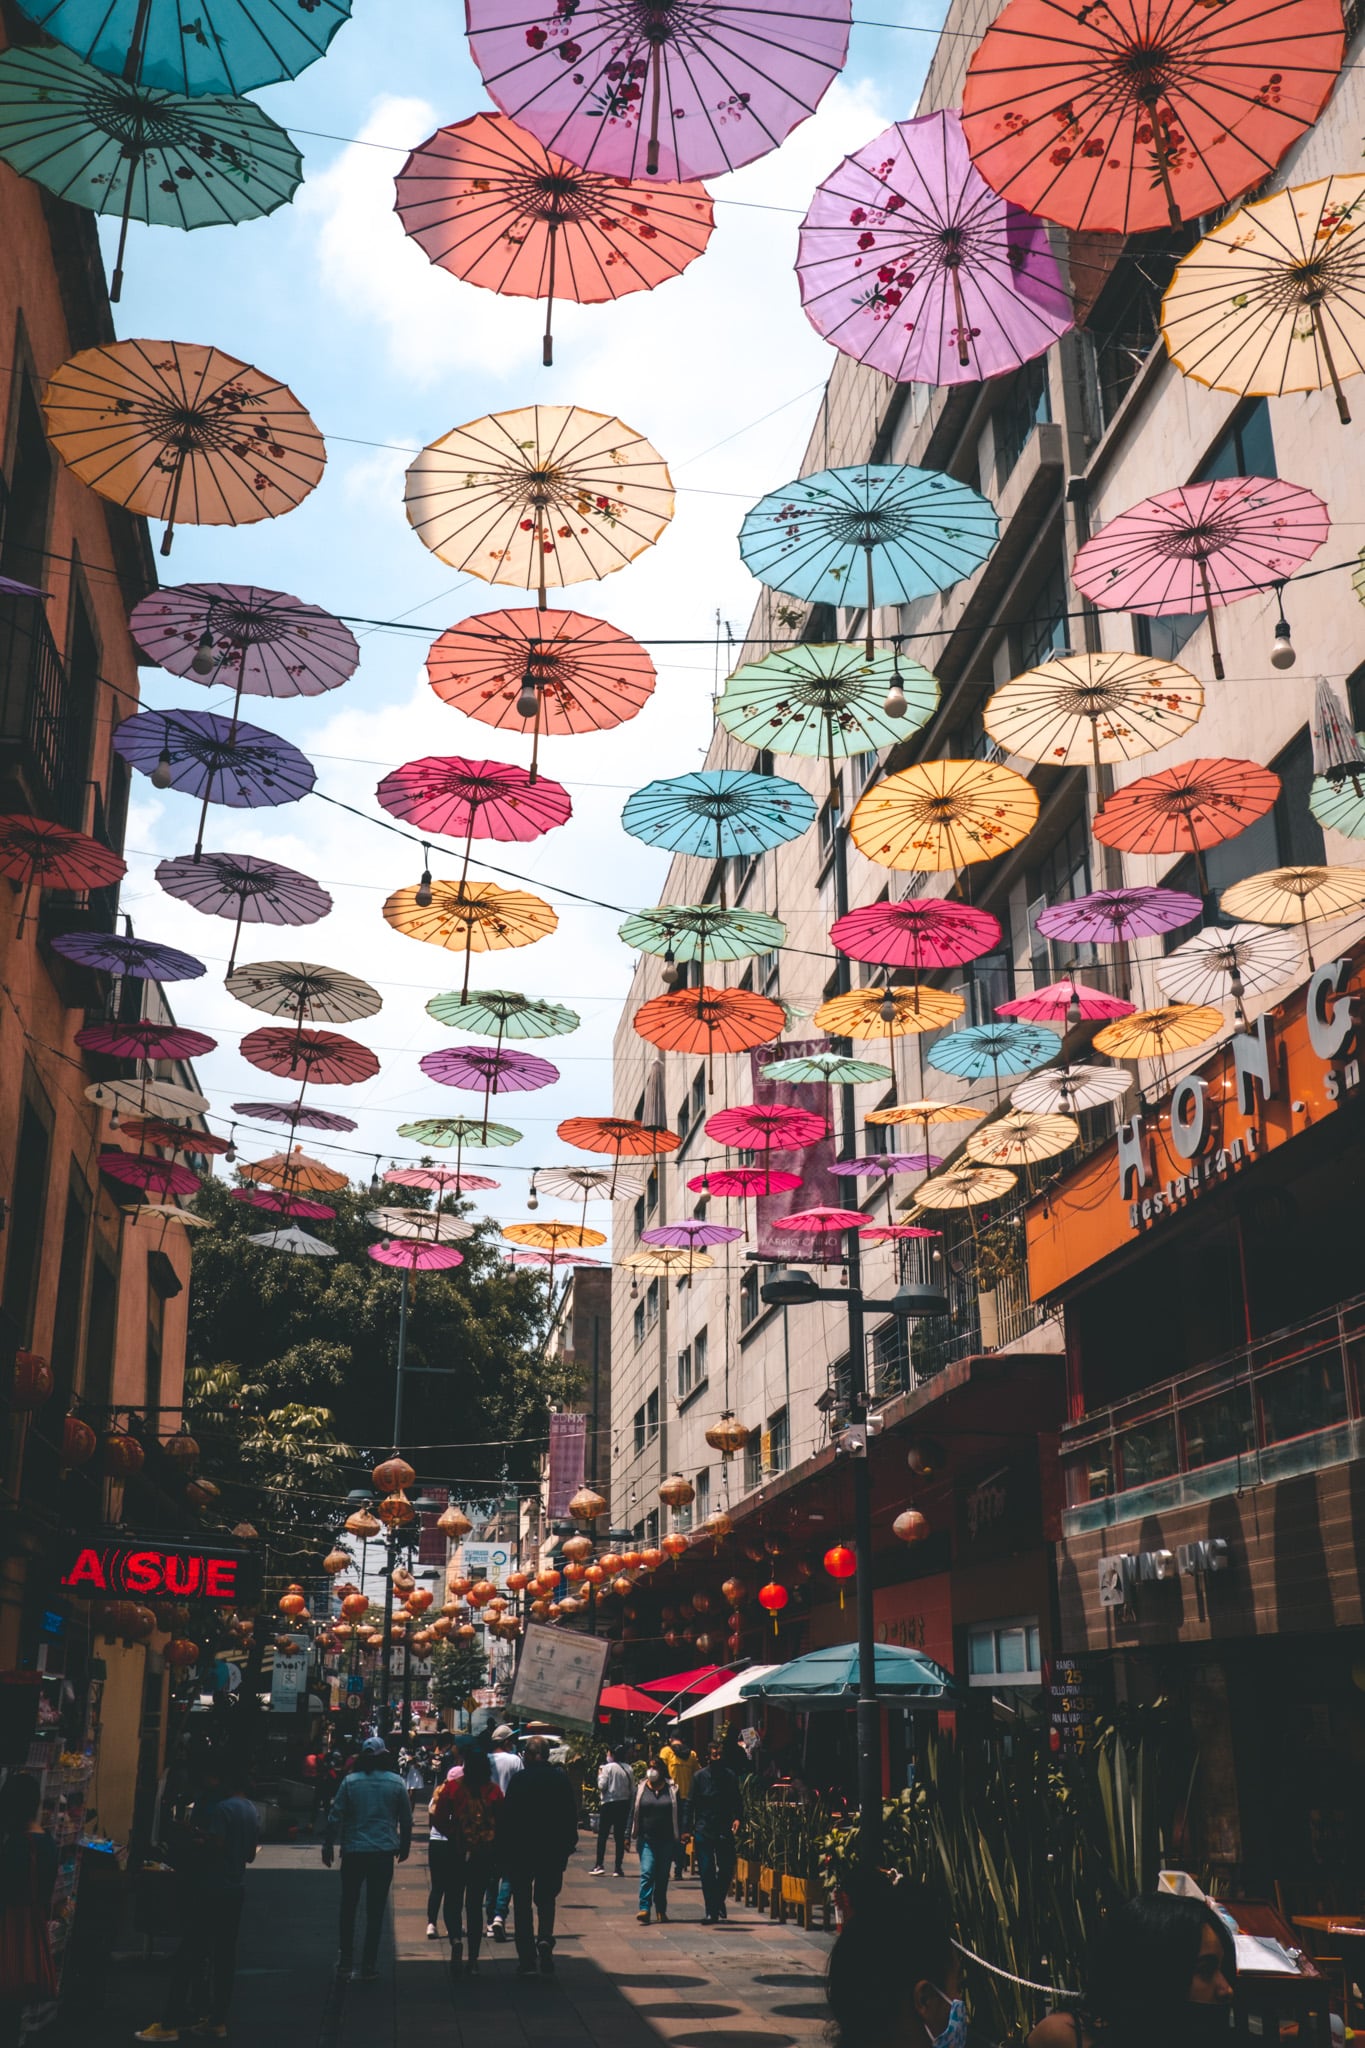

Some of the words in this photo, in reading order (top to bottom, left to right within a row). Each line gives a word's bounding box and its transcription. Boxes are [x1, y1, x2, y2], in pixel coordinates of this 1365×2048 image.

[1117, 957, 1360, 1201] HONG
[1129, 1126, 1258, 1229] Restaurant
[551, 1414, 584, 1424] CDMX
